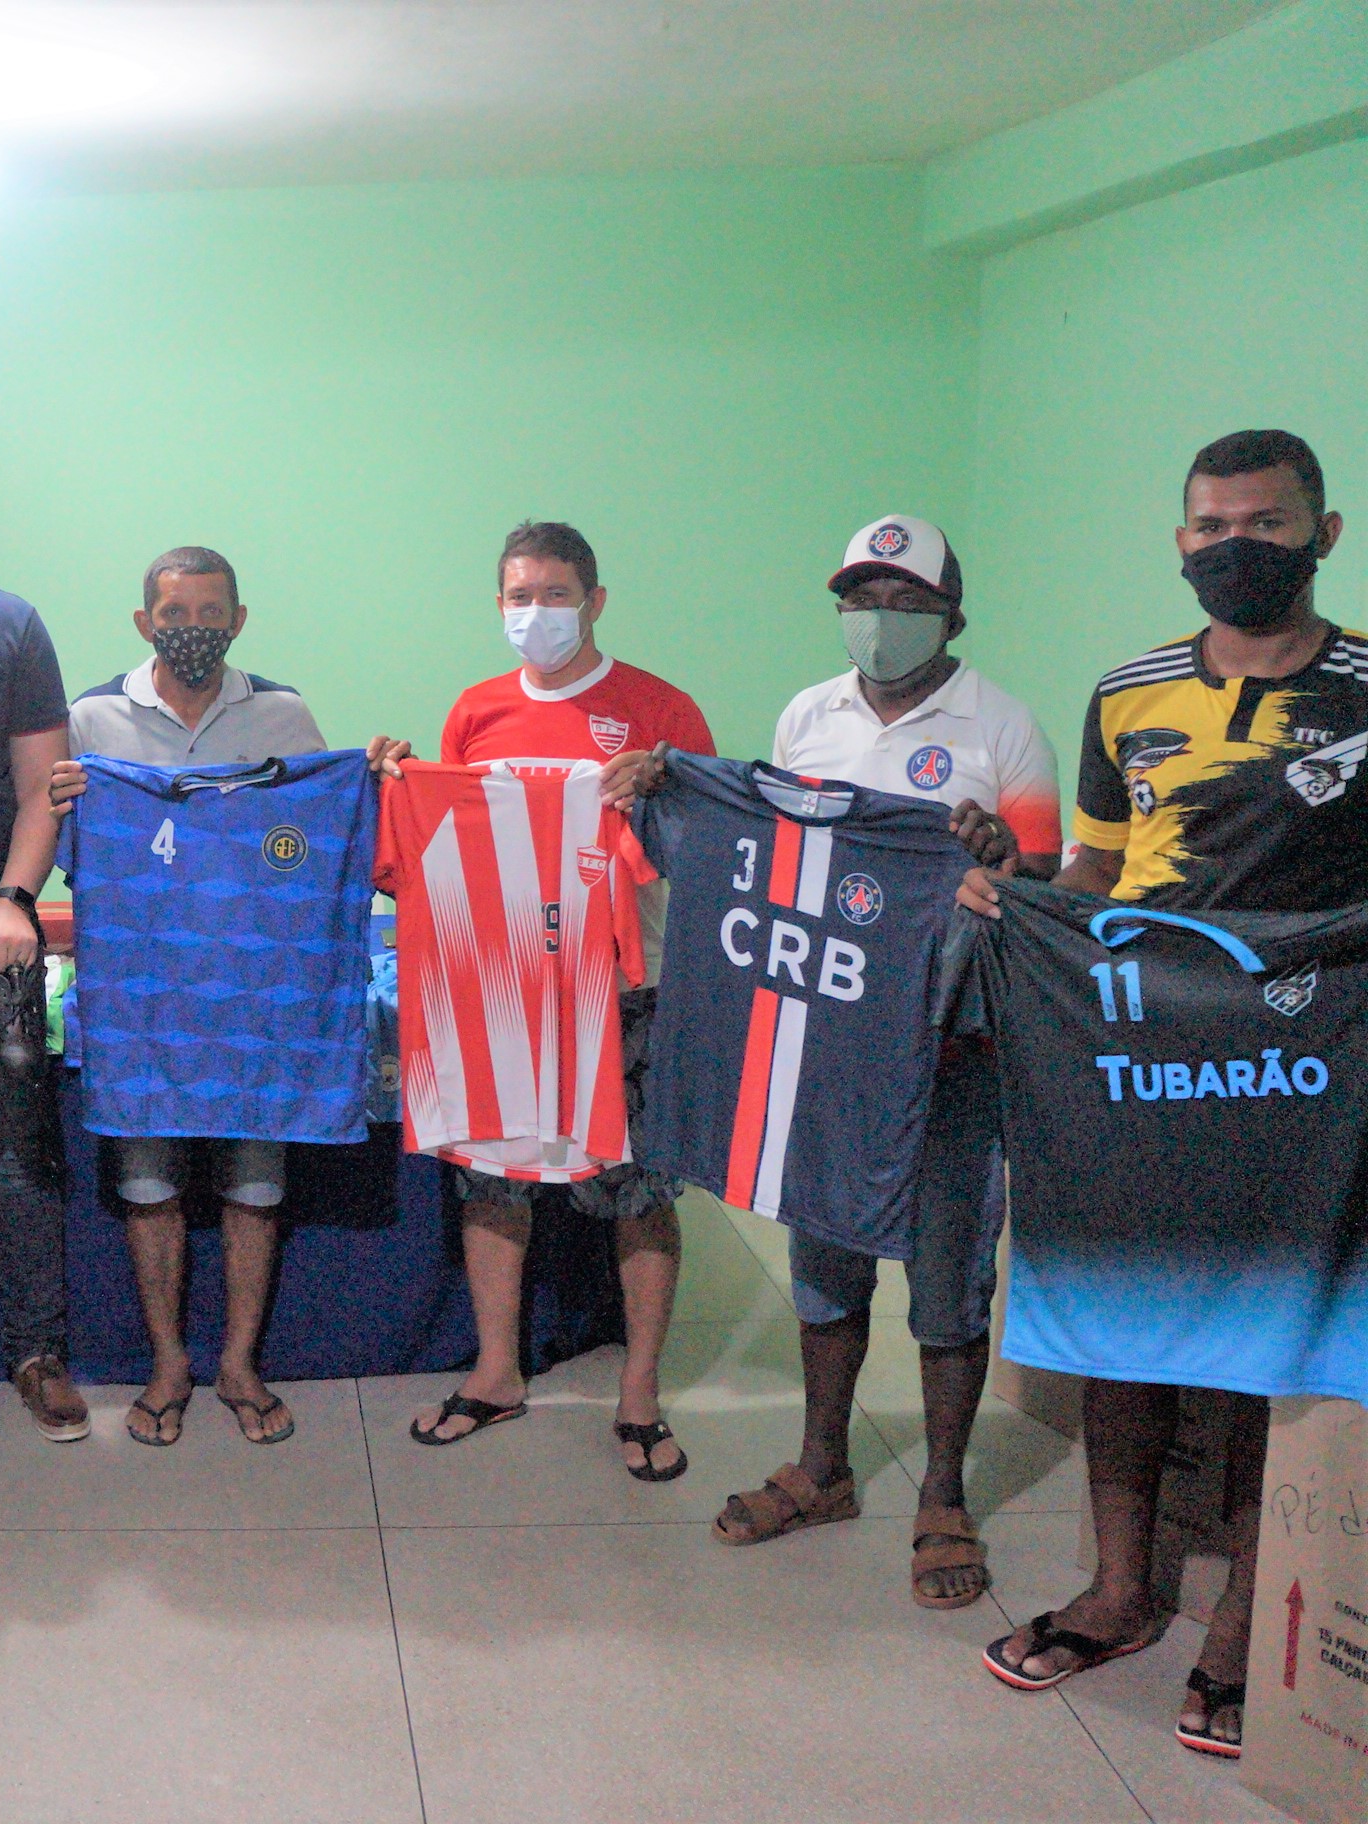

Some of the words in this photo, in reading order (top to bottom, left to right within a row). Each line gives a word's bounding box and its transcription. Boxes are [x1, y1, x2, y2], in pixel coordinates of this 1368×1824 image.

[150, 818, 177, 865] 4
[732, 837, 758, 893] 3
[541, 902, 561, 954] 9
[720, 907, 867, 1002] CRB
[1089, 961, 1144, 1022] 11
[1095, 1047, 1330, 1101] TUBARÃO
